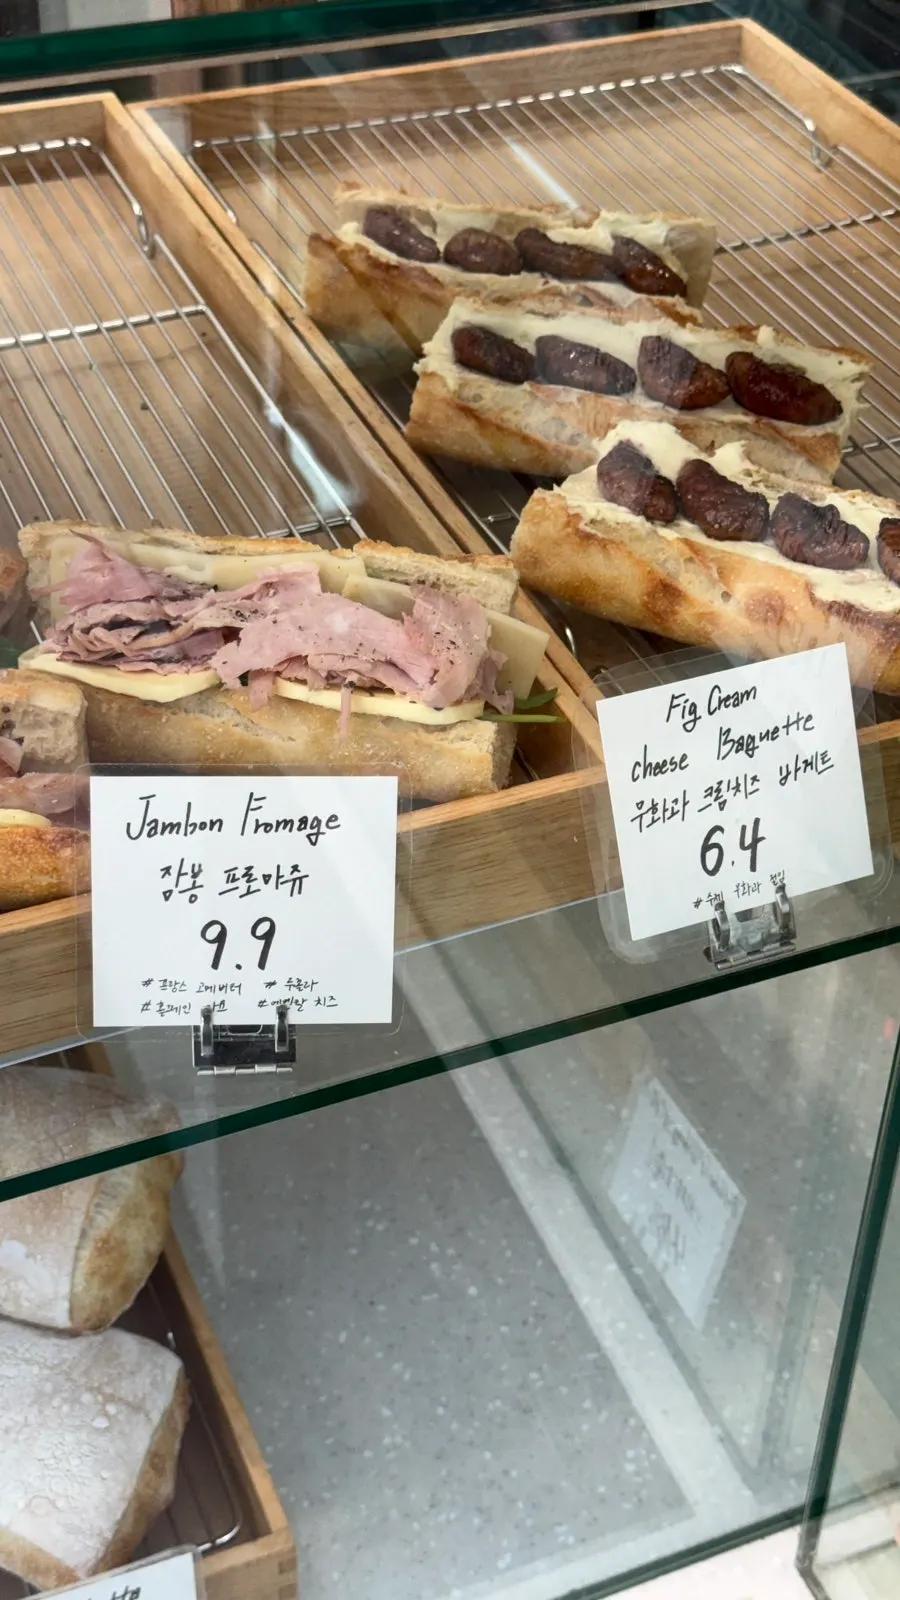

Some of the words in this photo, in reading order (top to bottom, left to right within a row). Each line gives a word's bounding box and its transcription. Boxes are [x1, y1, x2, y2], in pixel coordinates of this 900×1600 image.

[665, 692, 702, 733] Fig
[707, 684, 757, 716] Cream
[631, 744, 689, 783] cheese
[716, 711, 816, 761] Baguette
[125, 794, 224, 841] Jambon
[240, 791, 341, 847] Fromage
[630, 789, 690, 833] 무화과
[697, 773, 761, 813] 크림치즈
[779, 750, 834, 787] 바게트
[700, 817, 767, 877] 6.4
[159, 857, 204, 904] 잠봉
[218, 863, 310, 899] 프로마쥬
[200, 916, 276, 971] 9.9
[159, 978, 187, 993] 프랑스
[315, 995, 338, 1008] 치즈
